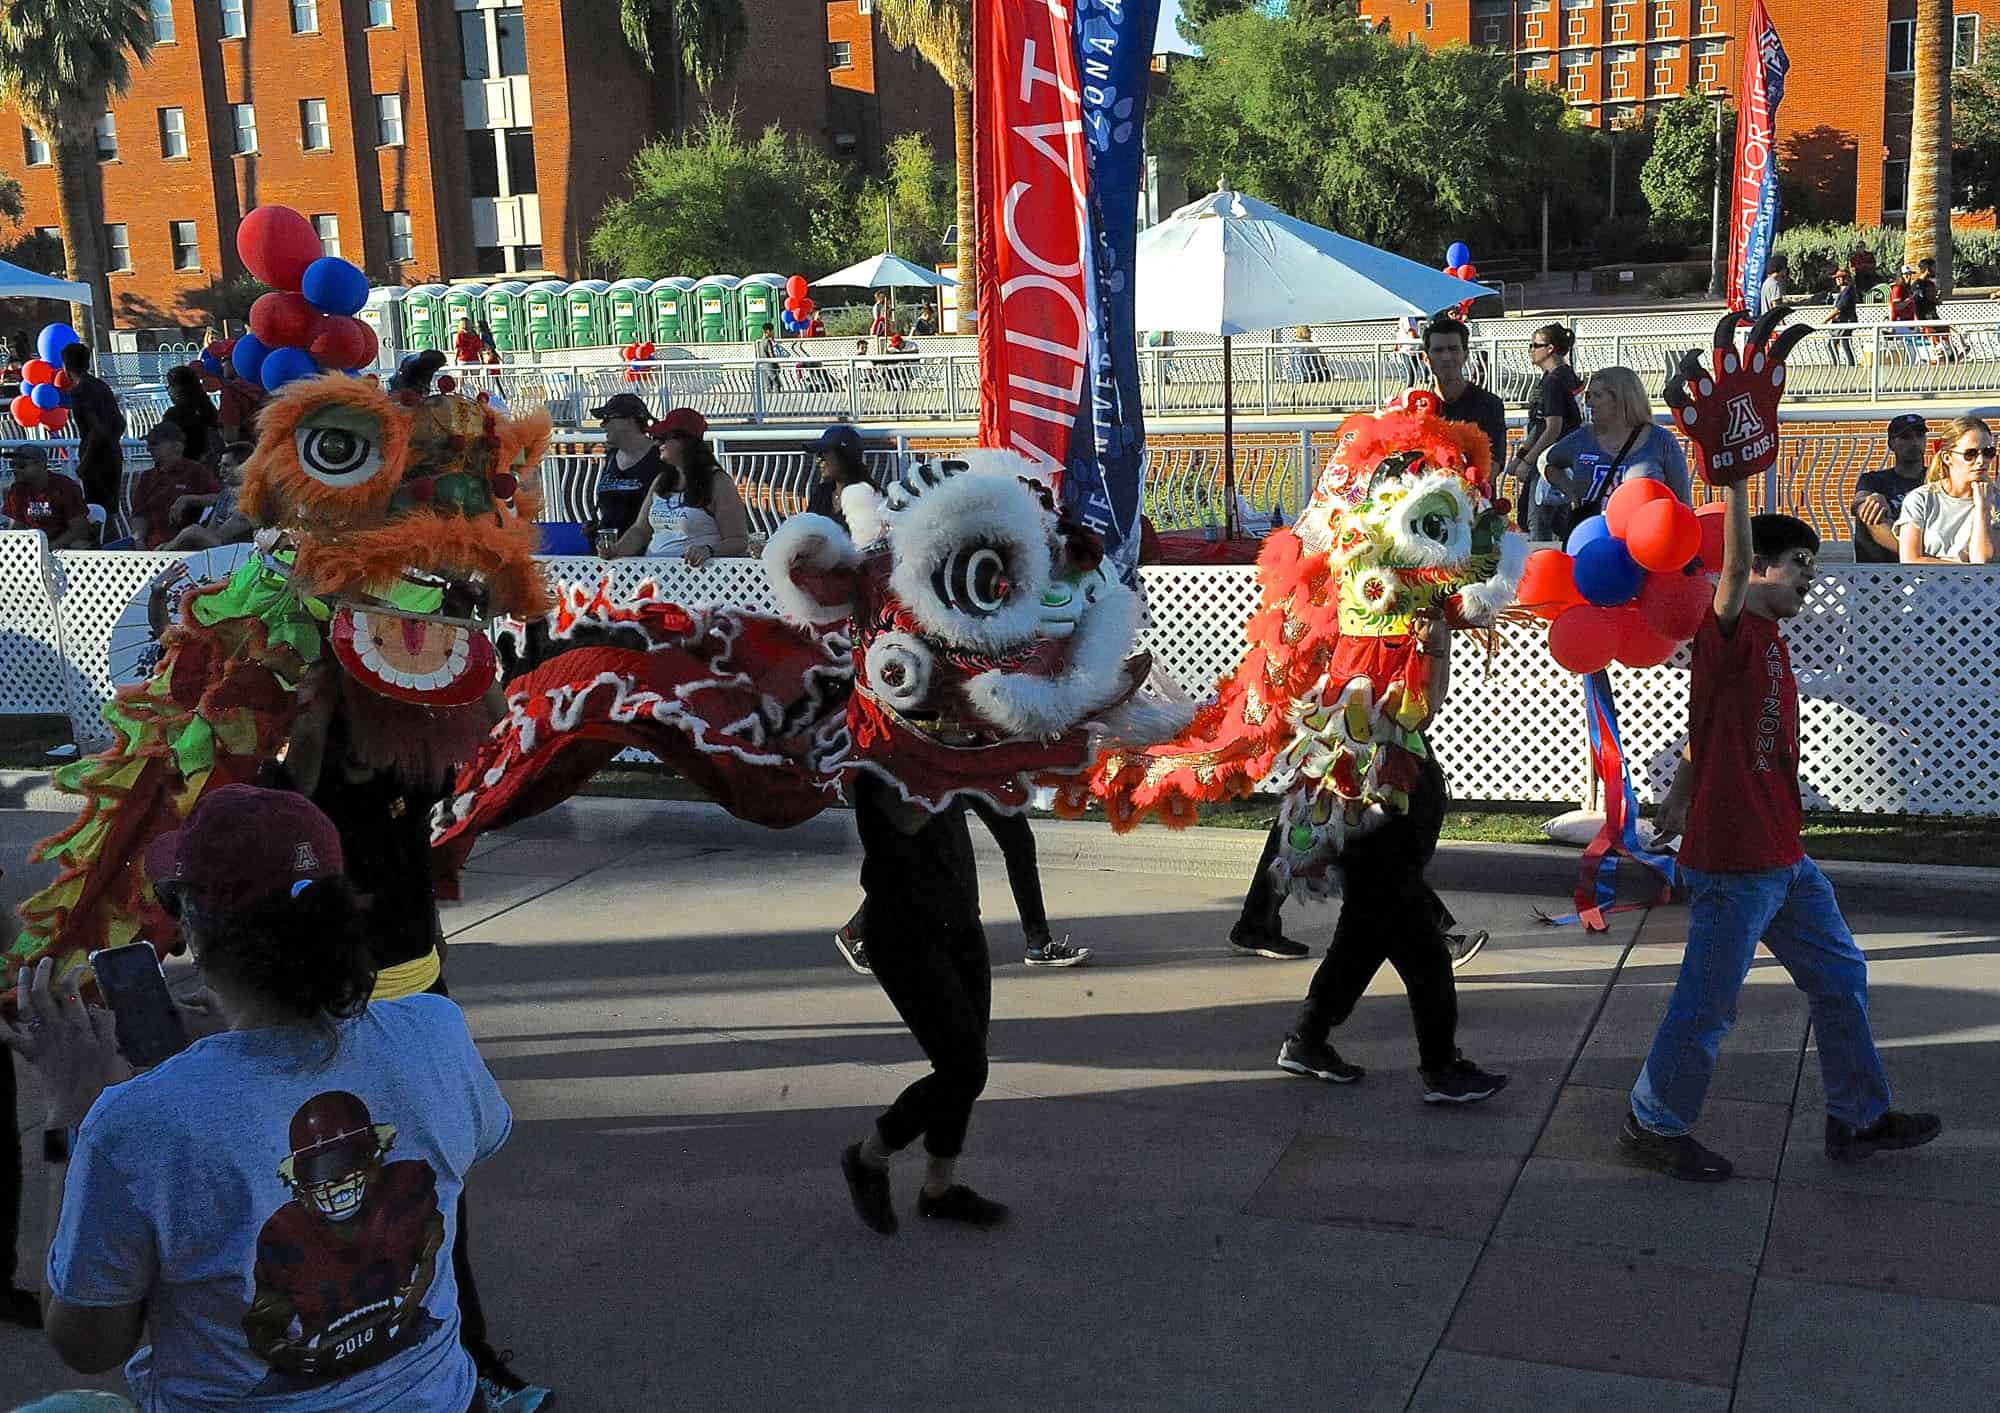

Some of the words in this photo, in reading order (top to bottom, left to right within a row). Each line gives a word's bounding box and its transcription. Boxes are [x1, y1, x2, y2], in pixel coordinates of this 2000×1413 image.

[1742, 123, 1771, 187] FOR
[1722, 392, 1764, 446] A
[1712, 451, 1734, 469] GO
[1752, 642, 1784, 772] ARIZONA
[296, 841, 319, 871] A
